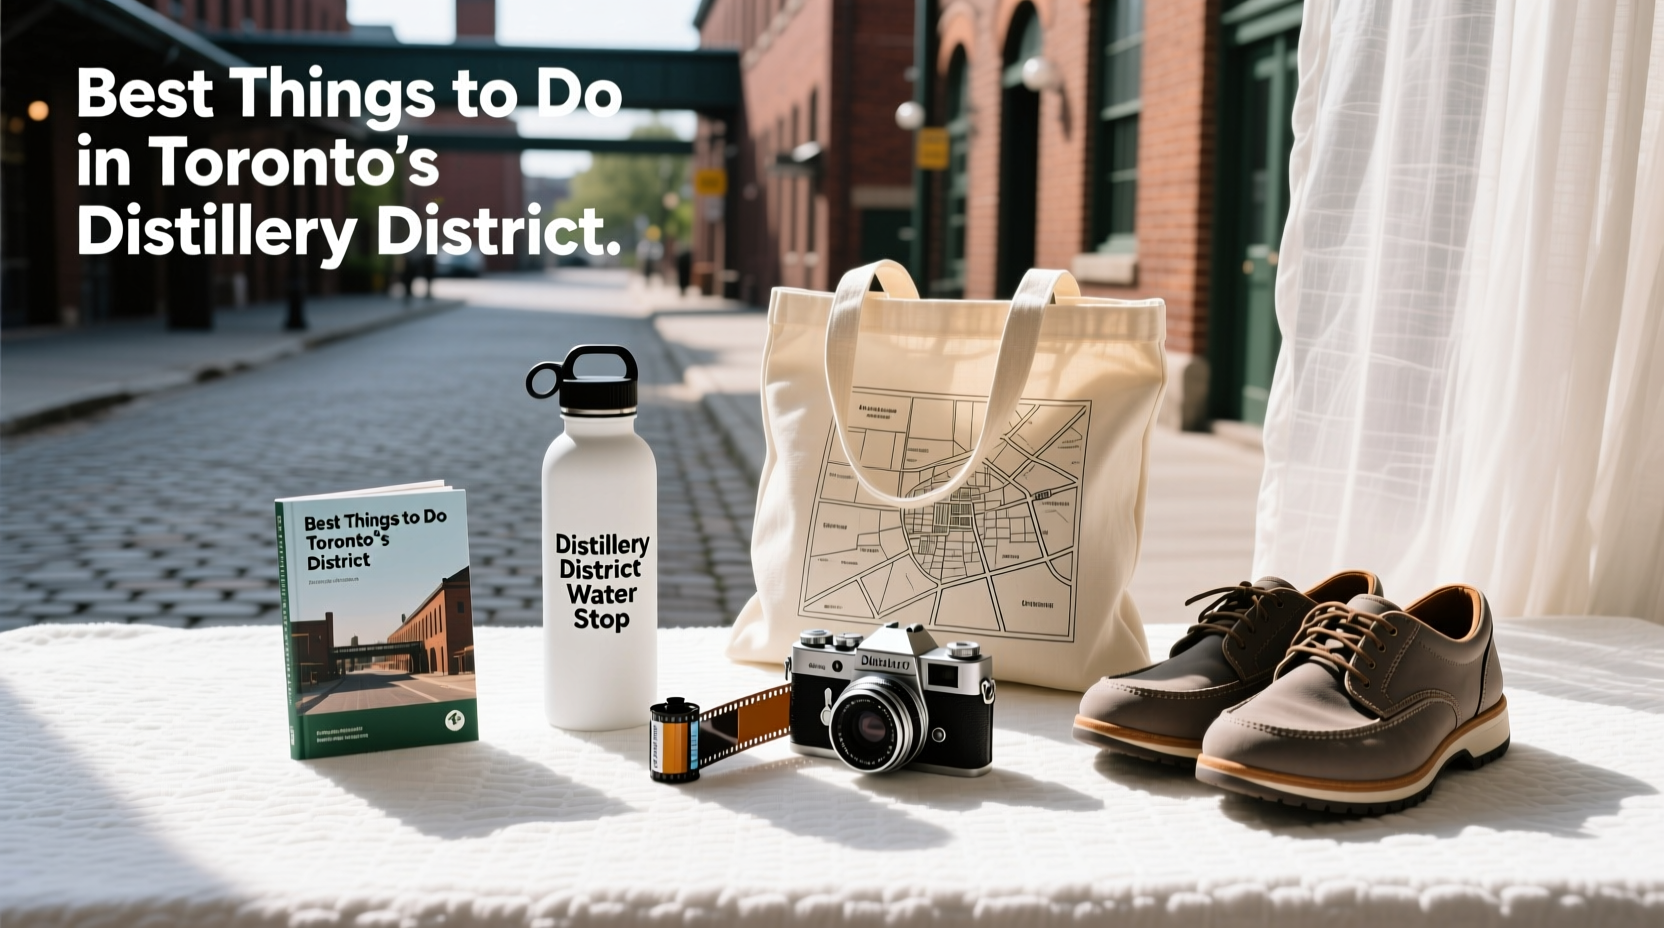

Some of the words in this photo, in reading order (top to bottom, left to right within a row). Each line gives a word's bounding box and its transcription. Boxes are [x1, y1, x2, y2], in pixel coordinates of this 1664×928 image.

[304, 514, 341, 532] Best
[343, 511, 400, 532] Things
[401, 510, 420, 525] to
[423, 508, 447, 524] Do
[556, 532, 650, 559] Distillery
[307, 552, 371, 571] District
[560, 558, 642, 580] District
[566, 583, 638, 605] Water
[573, 607, 631, 634] Stop
